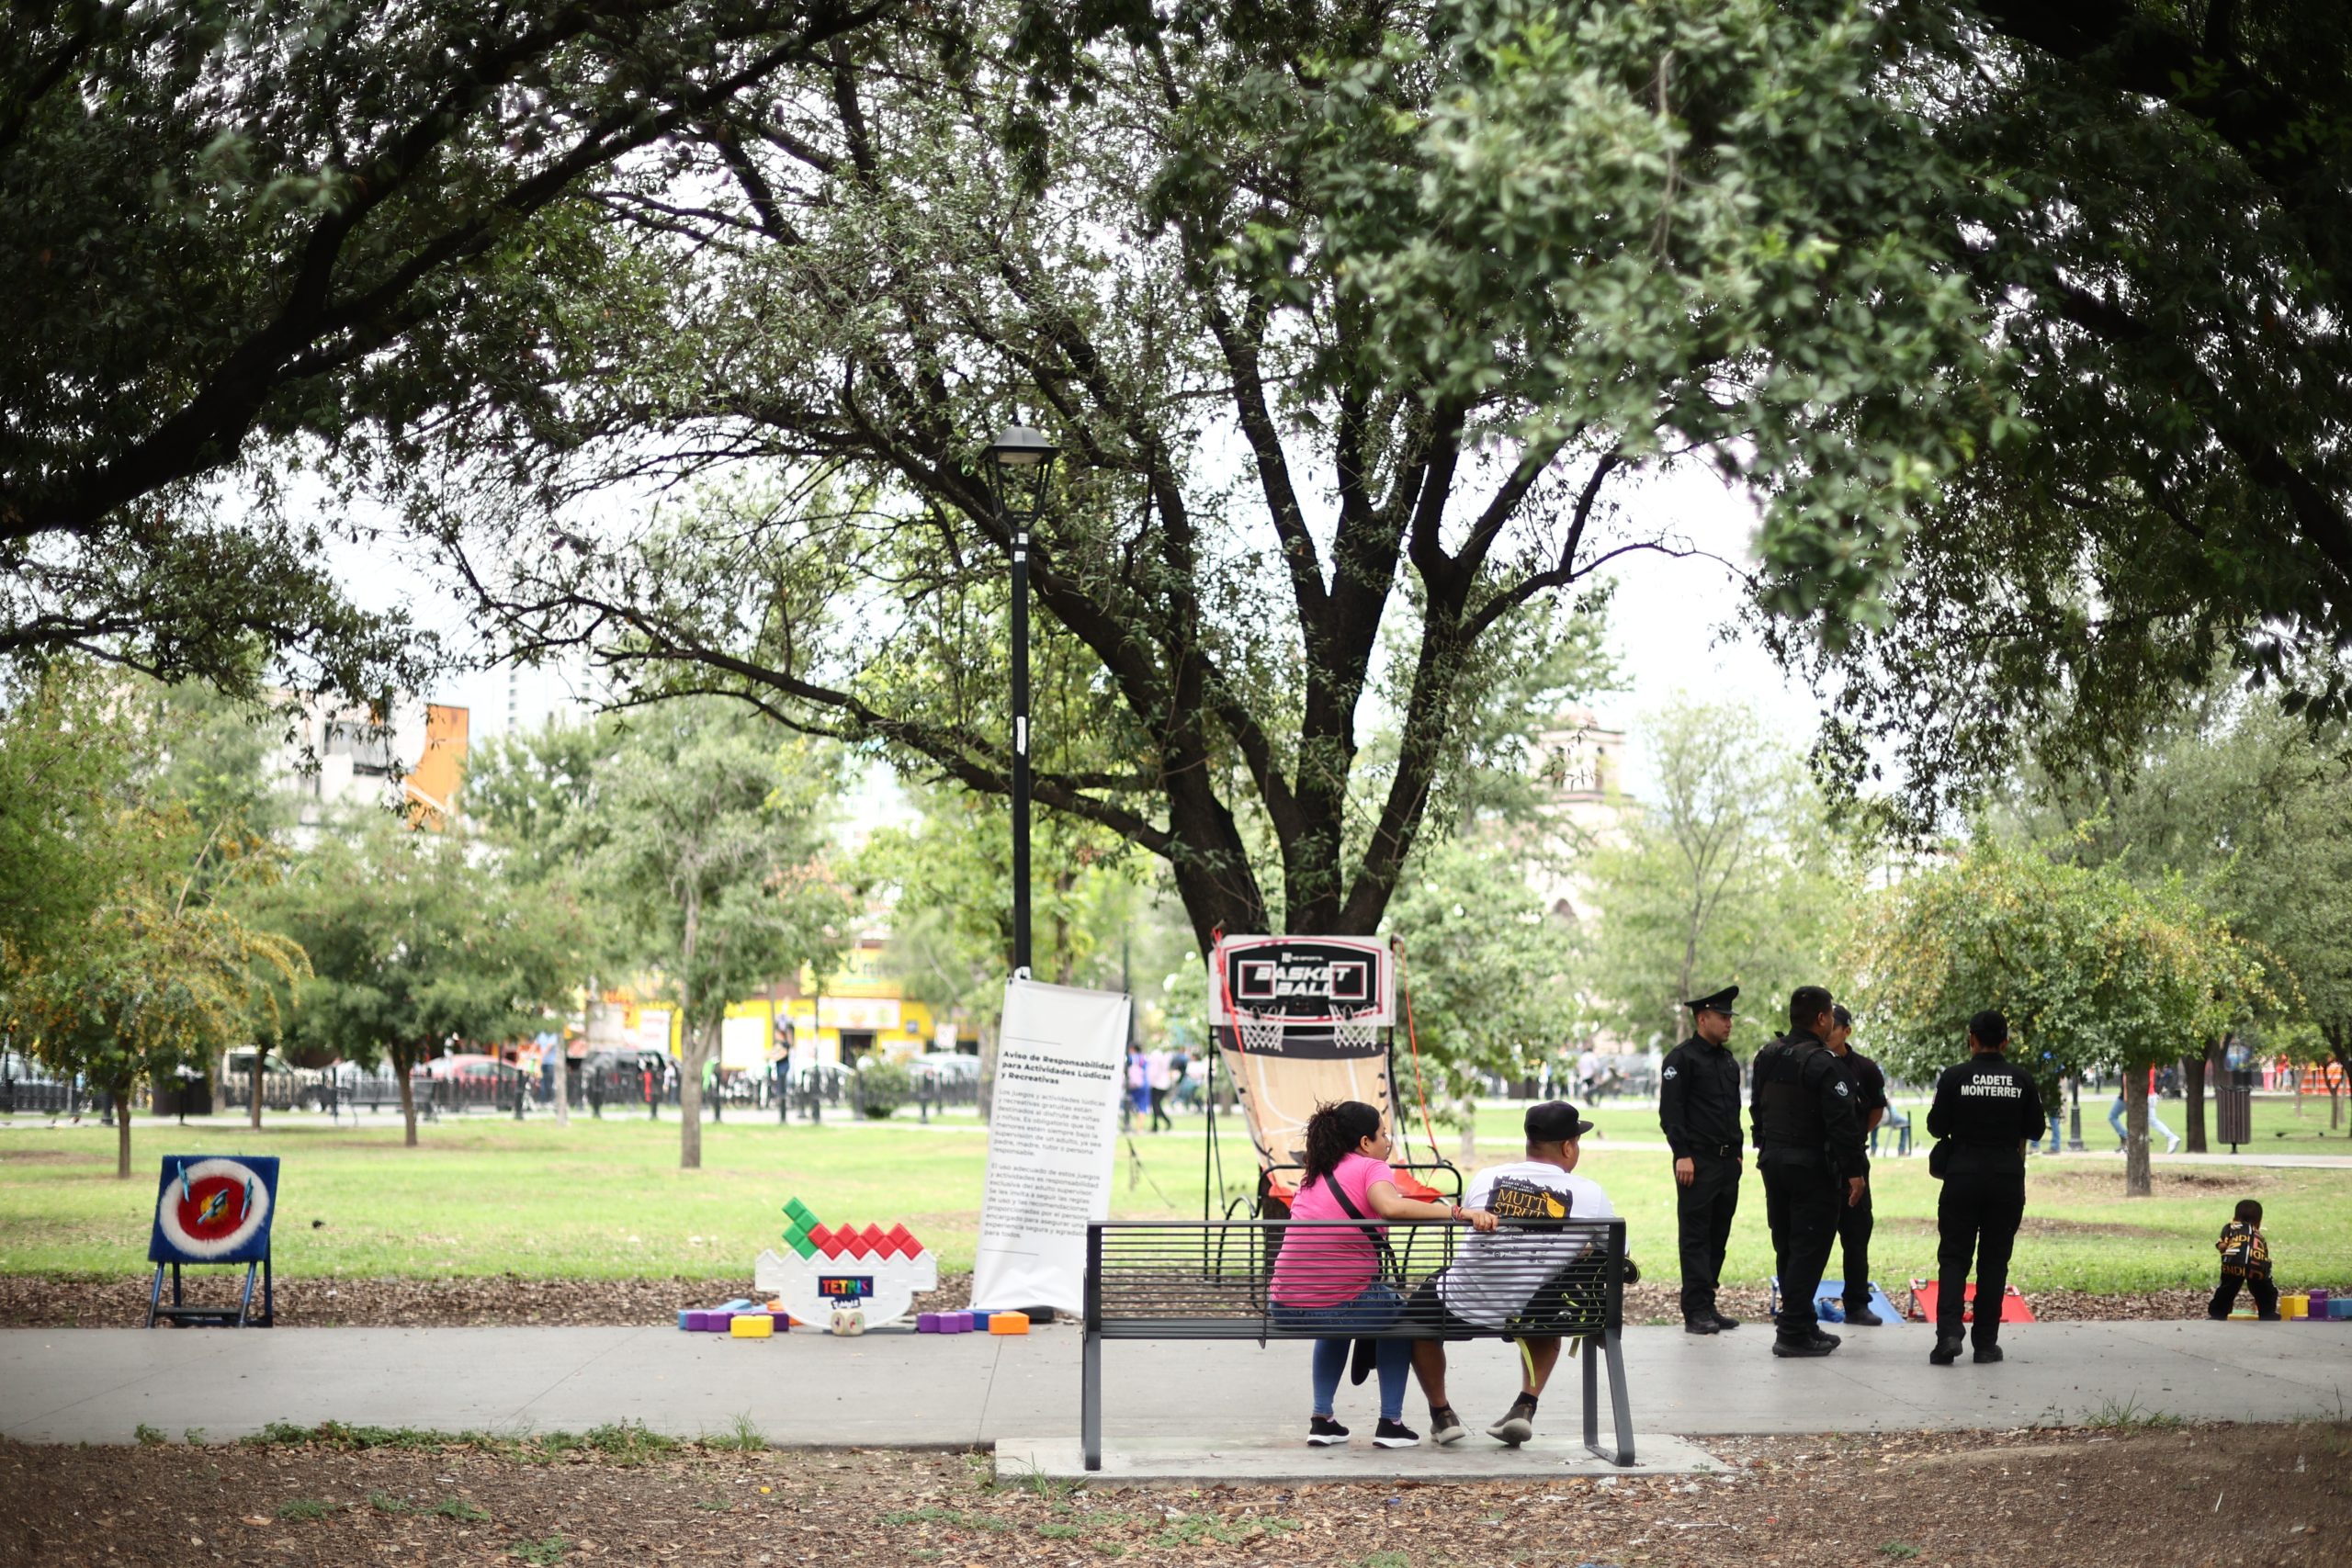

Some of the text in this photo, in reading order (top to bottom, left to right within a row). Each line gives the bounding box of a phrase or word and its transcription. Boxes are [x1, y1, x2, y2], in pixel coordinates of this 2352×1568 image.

[1254, 966, 1351, 981] BASKET
[1276, 982, 1336, 996] BALL
[1003, 1052, 1027, 1060] Aviso
[1043, 1056, 1114, 1070] Responsabilidad
[1009, 1072, 1059, 1084] Recreativas
[1024, 1065, 1075, 1076] Actividades
[1078, 1071, 1111, 1080] Lúdicas
[1973, 1074, 2013, 1086] CADETE
[1961, 1085, 2022, 1099] MONTERREY
[1497, 1189, 1546, 1212] MUTT
[822, 1280, 868, 1294] TETRIS
